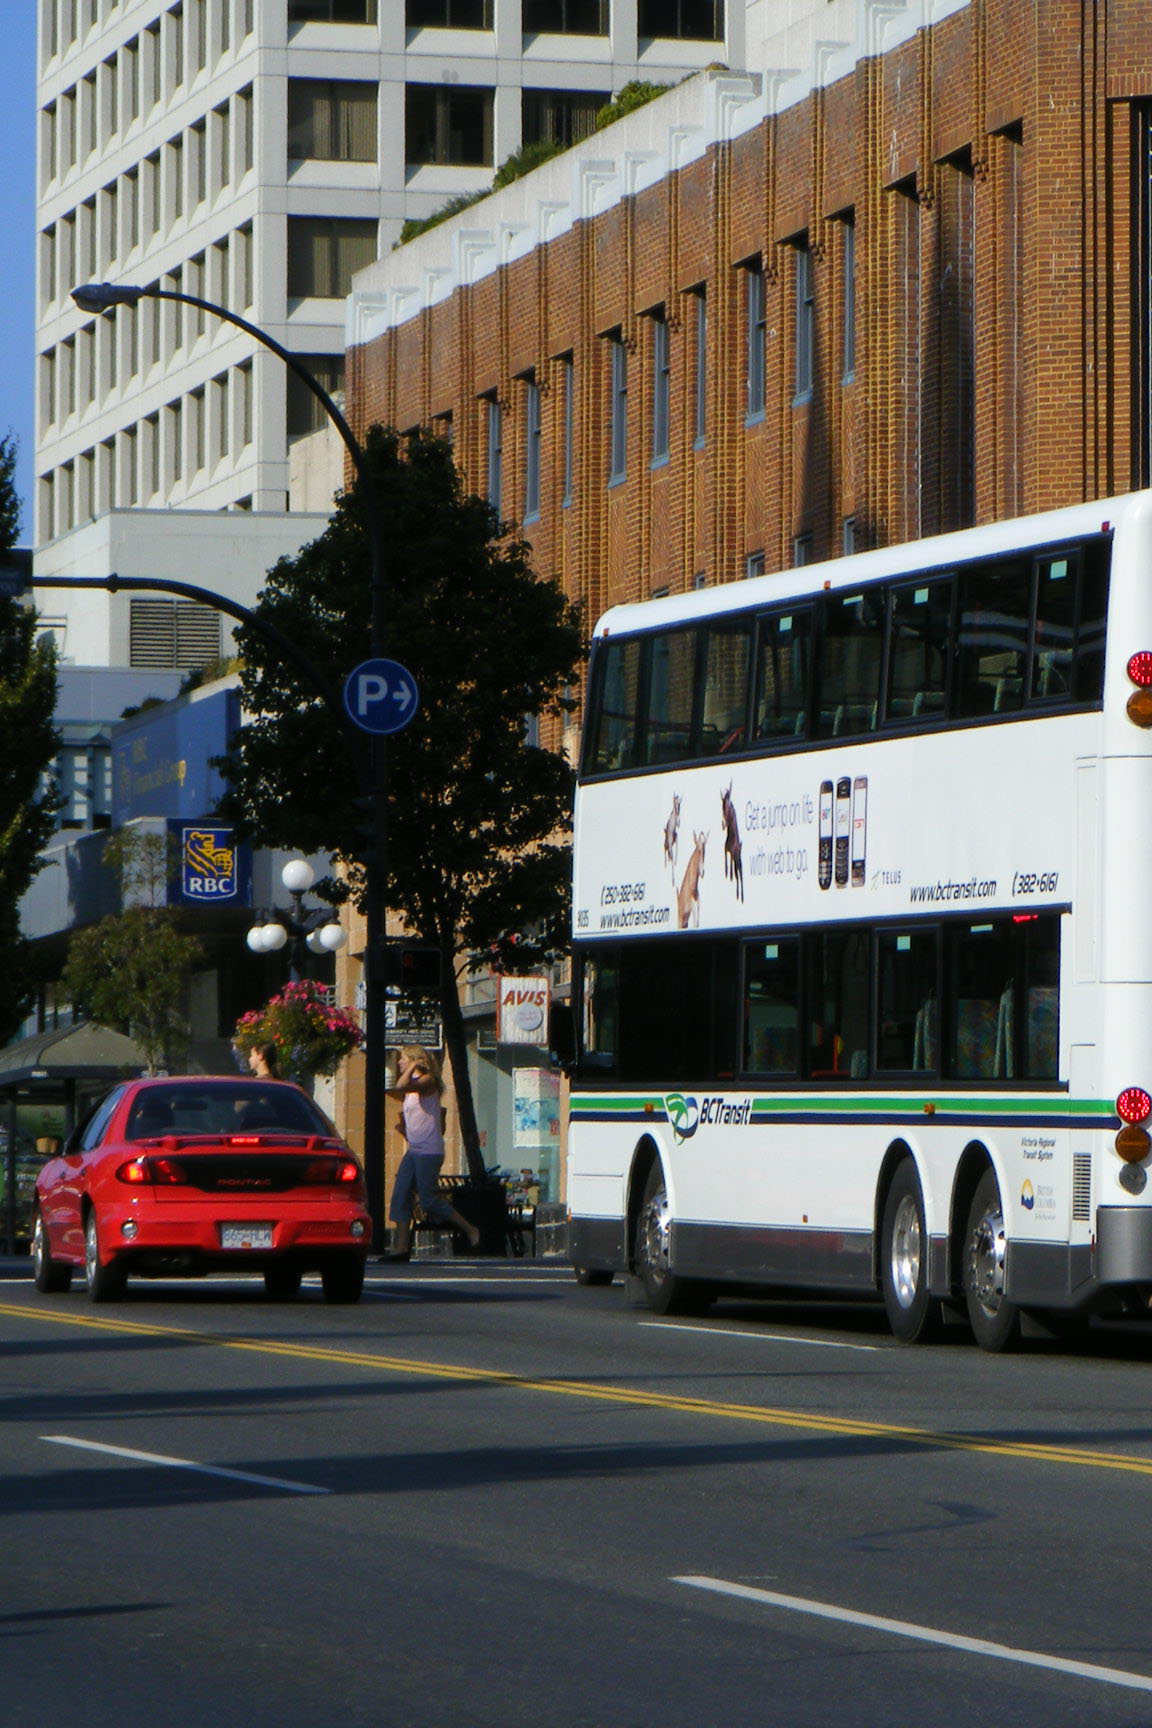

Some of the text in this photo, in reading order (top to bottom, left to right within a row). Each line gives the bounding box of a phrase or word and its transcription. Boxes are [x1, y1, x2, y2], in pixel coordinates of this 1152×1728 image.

[358, 674, 389, 716] P
[745, 800, 760, 832] Get
[766, 800, 788, 836] jump
[789, 802, 801, 827] on
[802, 793, 814, 825] life
[749, 845, 767, 877] with
[767, 844, 785, 875] web
[786, 845, 795, 874] to
[189, 877, 232, 893] RBC
[882, 870, 902, 885] TELUS
[910, 876, 997, 903] www.bctransit.com
[600, 904, 671, 930] www.bctransit.com
[502, 989, 547, 1007] AVIS
